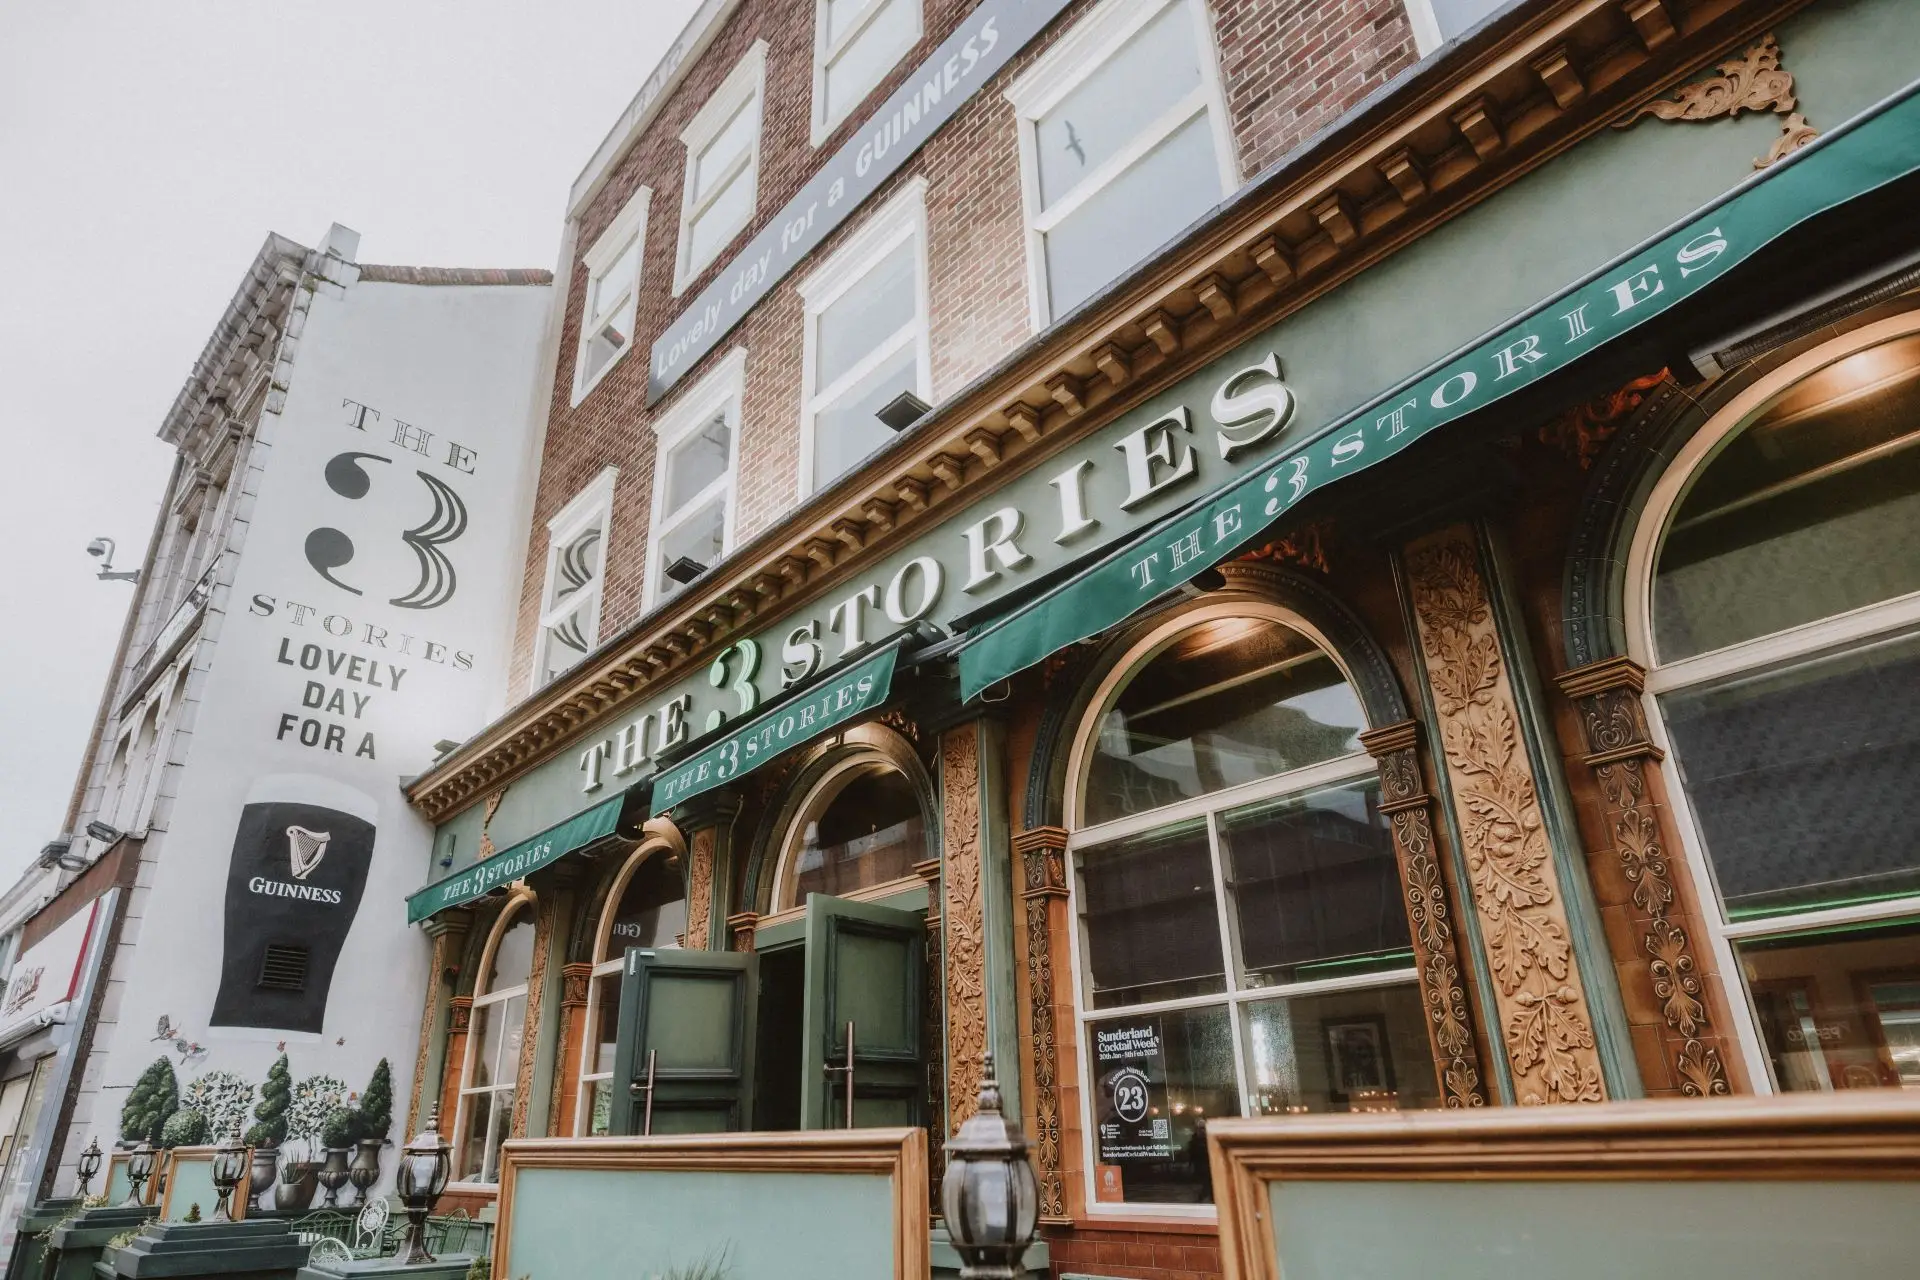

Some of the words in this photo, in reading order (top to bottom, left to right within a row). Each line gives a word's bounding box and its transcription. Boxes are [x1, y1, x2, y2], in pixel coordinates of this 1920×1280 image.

[656, 298, 723, 380] Lovely
[730, 246, 772, 305] day
[781, 201, 818, 254] for
[827, 176, 845, 208] a
[855, 16, 999, 178] GUINNESS
[342, 398, 478, 475] THE
[1131, 503, 1242, 591] THE
[1264, 455, 1309, 516] 3
[1331, 226, 1728, 467] STORIES
[304, 451, 468, 610] 3
[581, 693, 692, 794] THE
[705, 638, 762, 734] 3
[781, 351, 1296, 690] STORIES
[249, 594, 474, 672] STORIES
[277, 637, 407, 692] LOVELY
[302, 680, 371, 719] DAY
[276, 713, 346, 753] FOR
[355, 732, 376, 760] A
[664, 760, 712, 800] THE
[717, 739, 739, 778] 3
[746, 674, 873, 759] STORIES
[249, 876, 341, 904] GUINNESS
[442, 878, 471, 901] THE
[473, 866, 486, 895] 3
[486, 840, 552, 885] STORIES
[1098, 1026, 1153, 1043] Sunderland
[1099, 1040, 1132, 1052] Cocktail
[1132, 1037, 1157, 1049] Week
[1109, 1068, 1126, 1085] Venue
[1126, 1066, 1151, 1083] Number
[1118, 1086, 1144, 1111] 23
